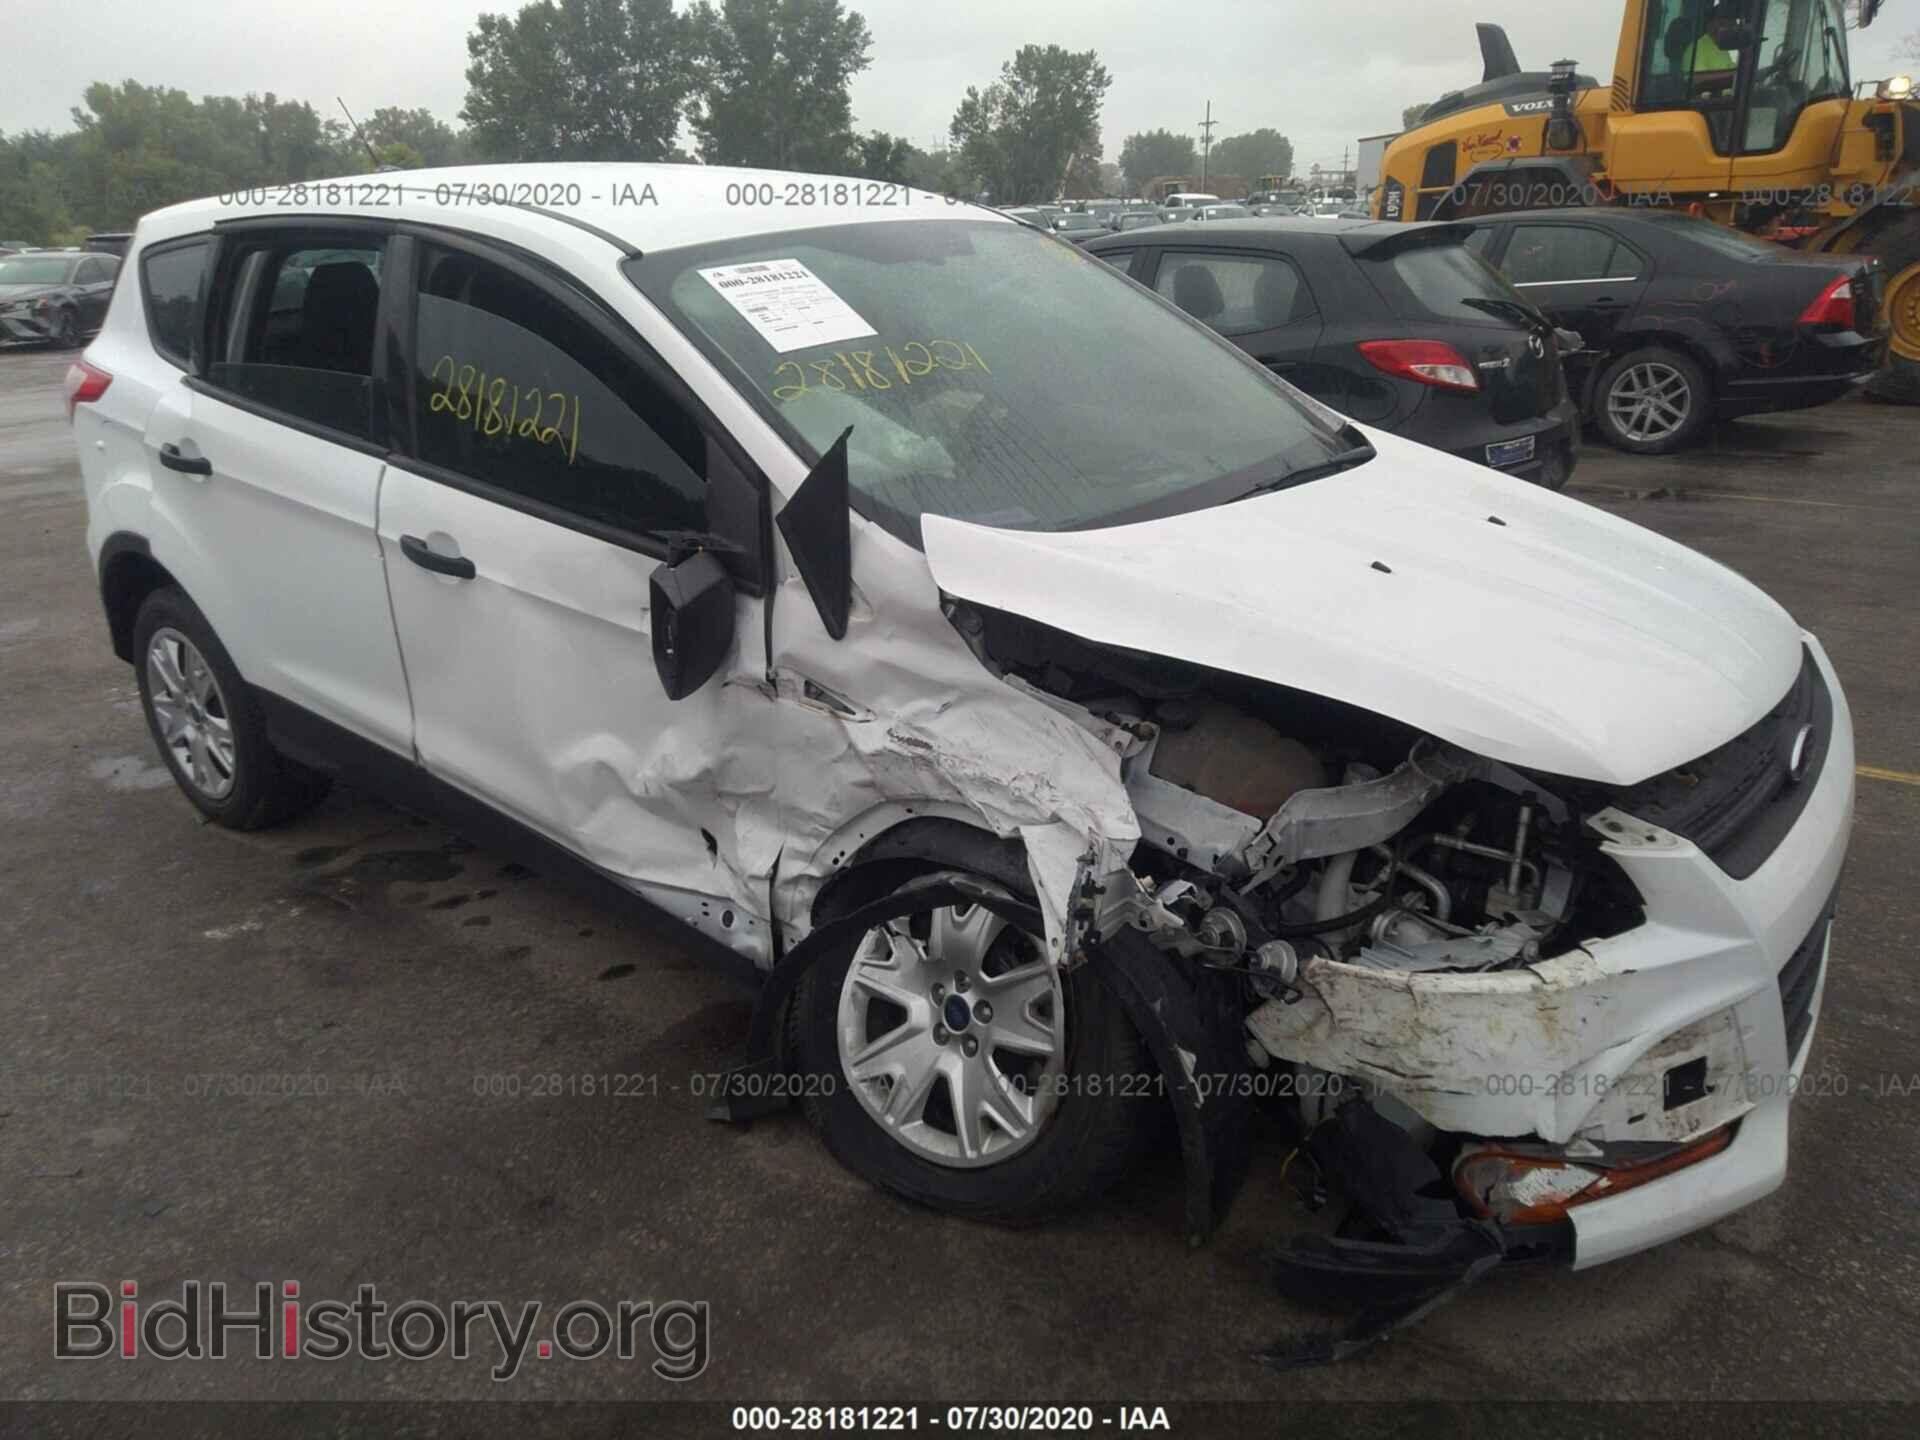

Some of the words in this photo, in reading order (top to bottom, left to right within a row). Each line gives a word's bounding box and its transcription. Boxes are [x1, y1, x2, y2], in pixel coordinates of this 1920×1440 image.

[1512, 99, 1571, 112] VOLV
[772, 339, 992, 401] 28181221
[430, 353, 580, 466] 28181221
